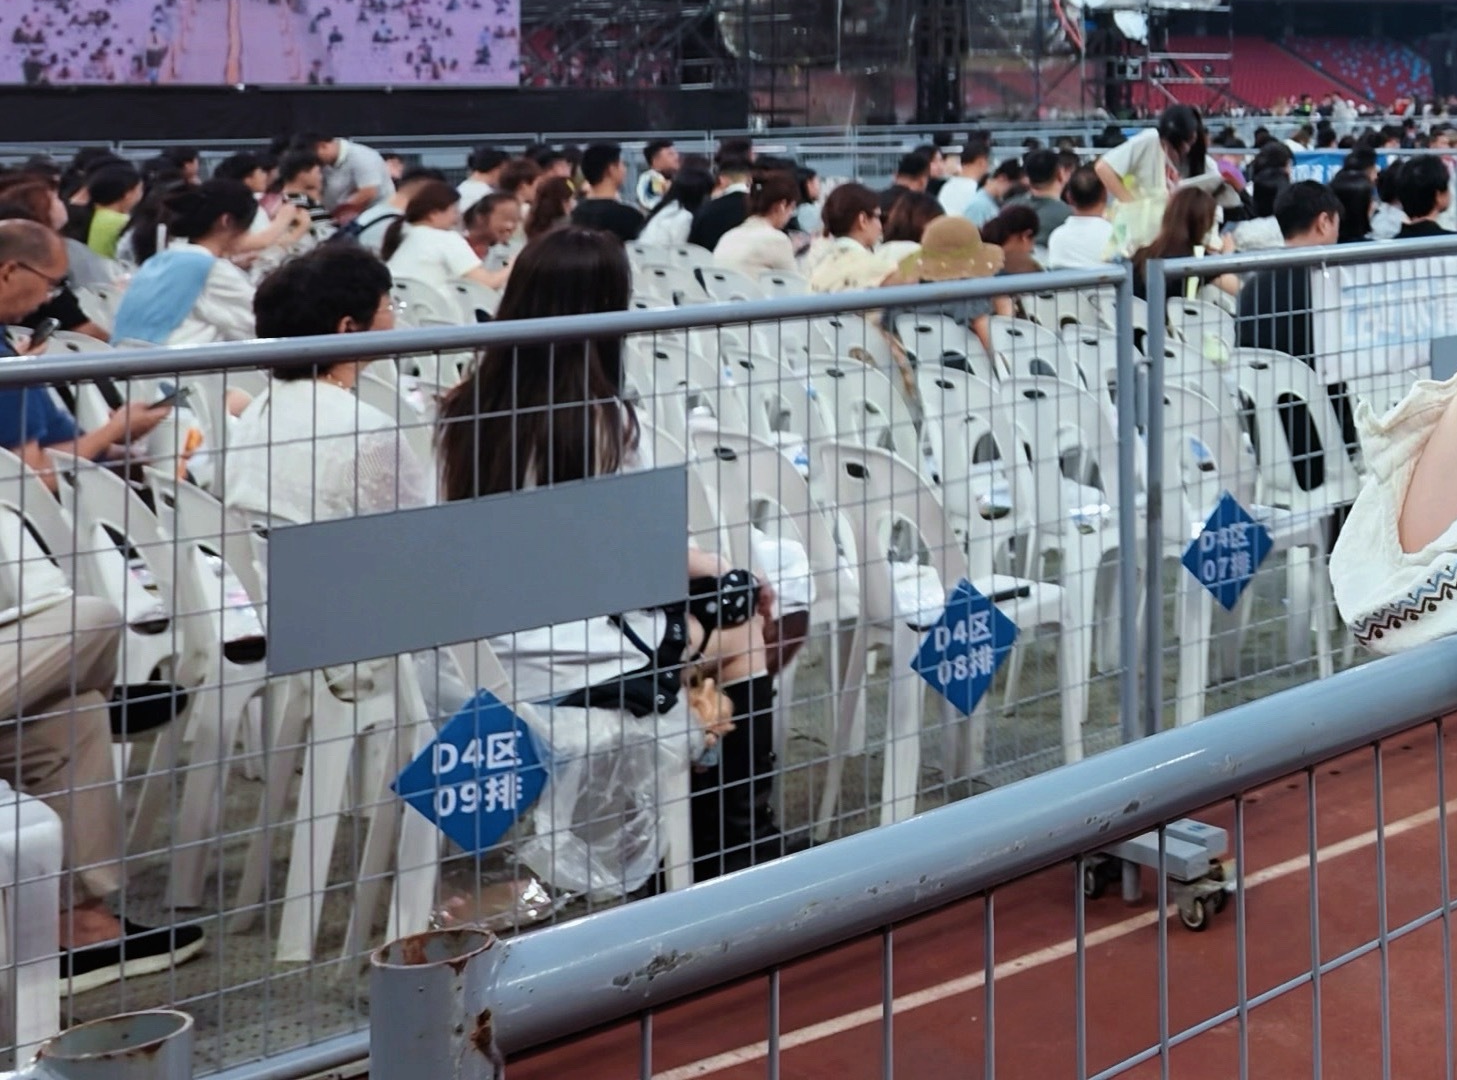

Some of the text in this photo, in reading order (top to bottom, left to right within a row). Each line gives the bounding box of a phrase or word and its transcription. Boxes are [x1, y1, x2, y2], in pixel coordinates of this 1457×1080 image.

[934, 610, 993, 653] D4区
[936, 643, 995, 686] 08排
[432, 730, 523, 775] D4区
[433, 772, 523, 817] 09排
